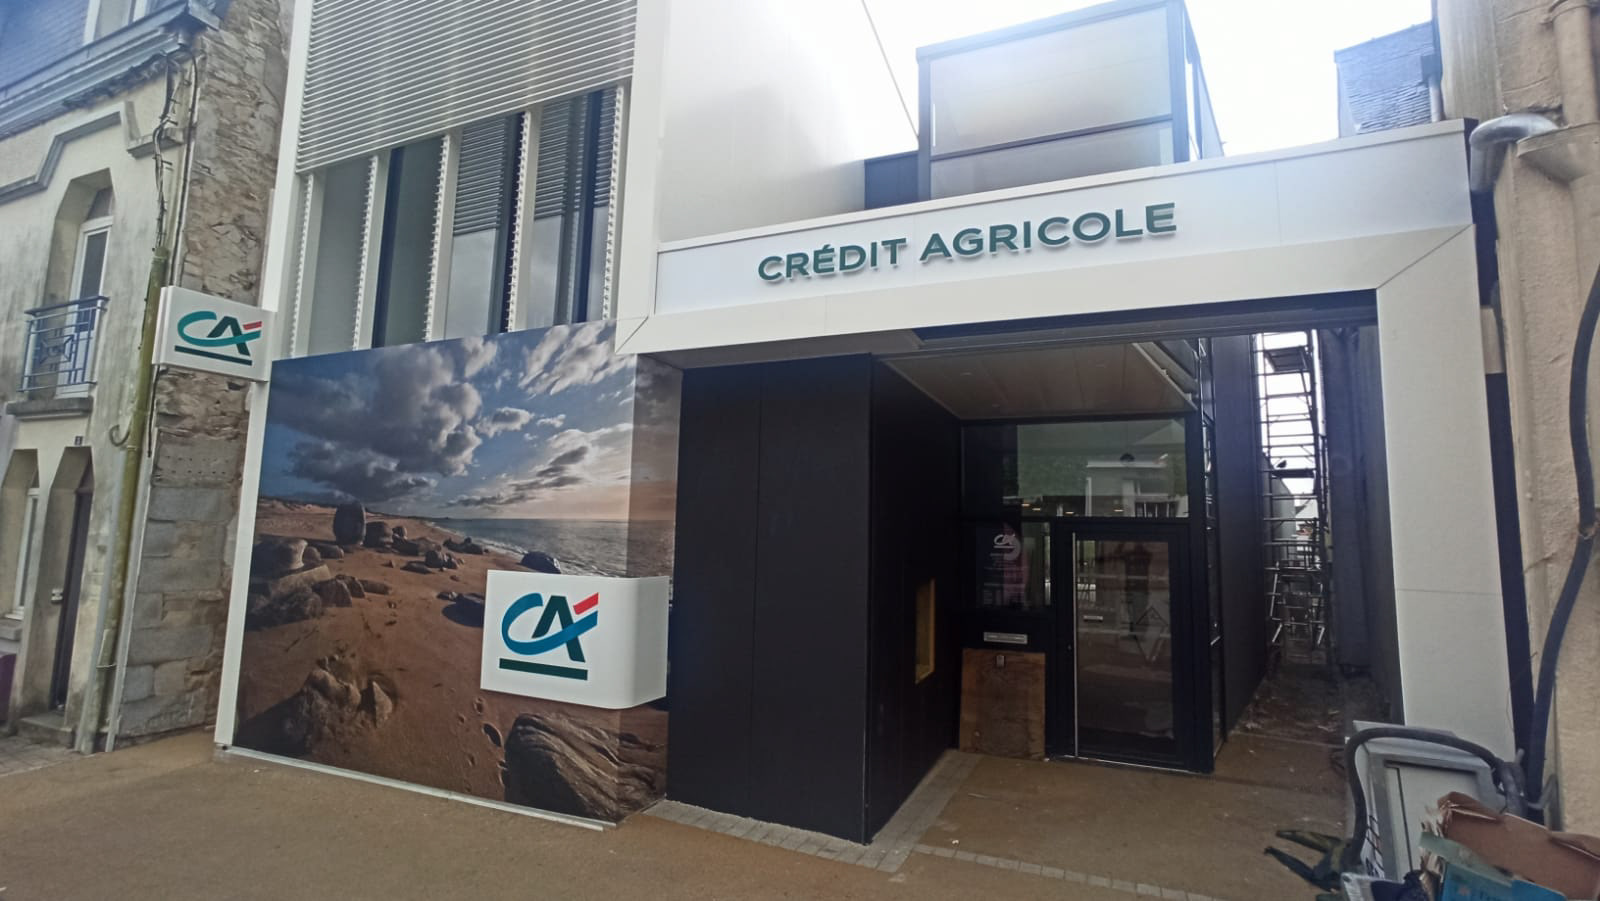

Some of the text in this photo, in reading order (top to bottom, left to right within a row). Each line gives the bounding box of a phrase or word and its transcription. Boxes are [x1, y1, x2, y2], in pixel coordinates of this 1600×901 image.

[757, 201, 1177, 282] CRÉDIT AGRICOLE
[501, 592, 599, 663] CA
